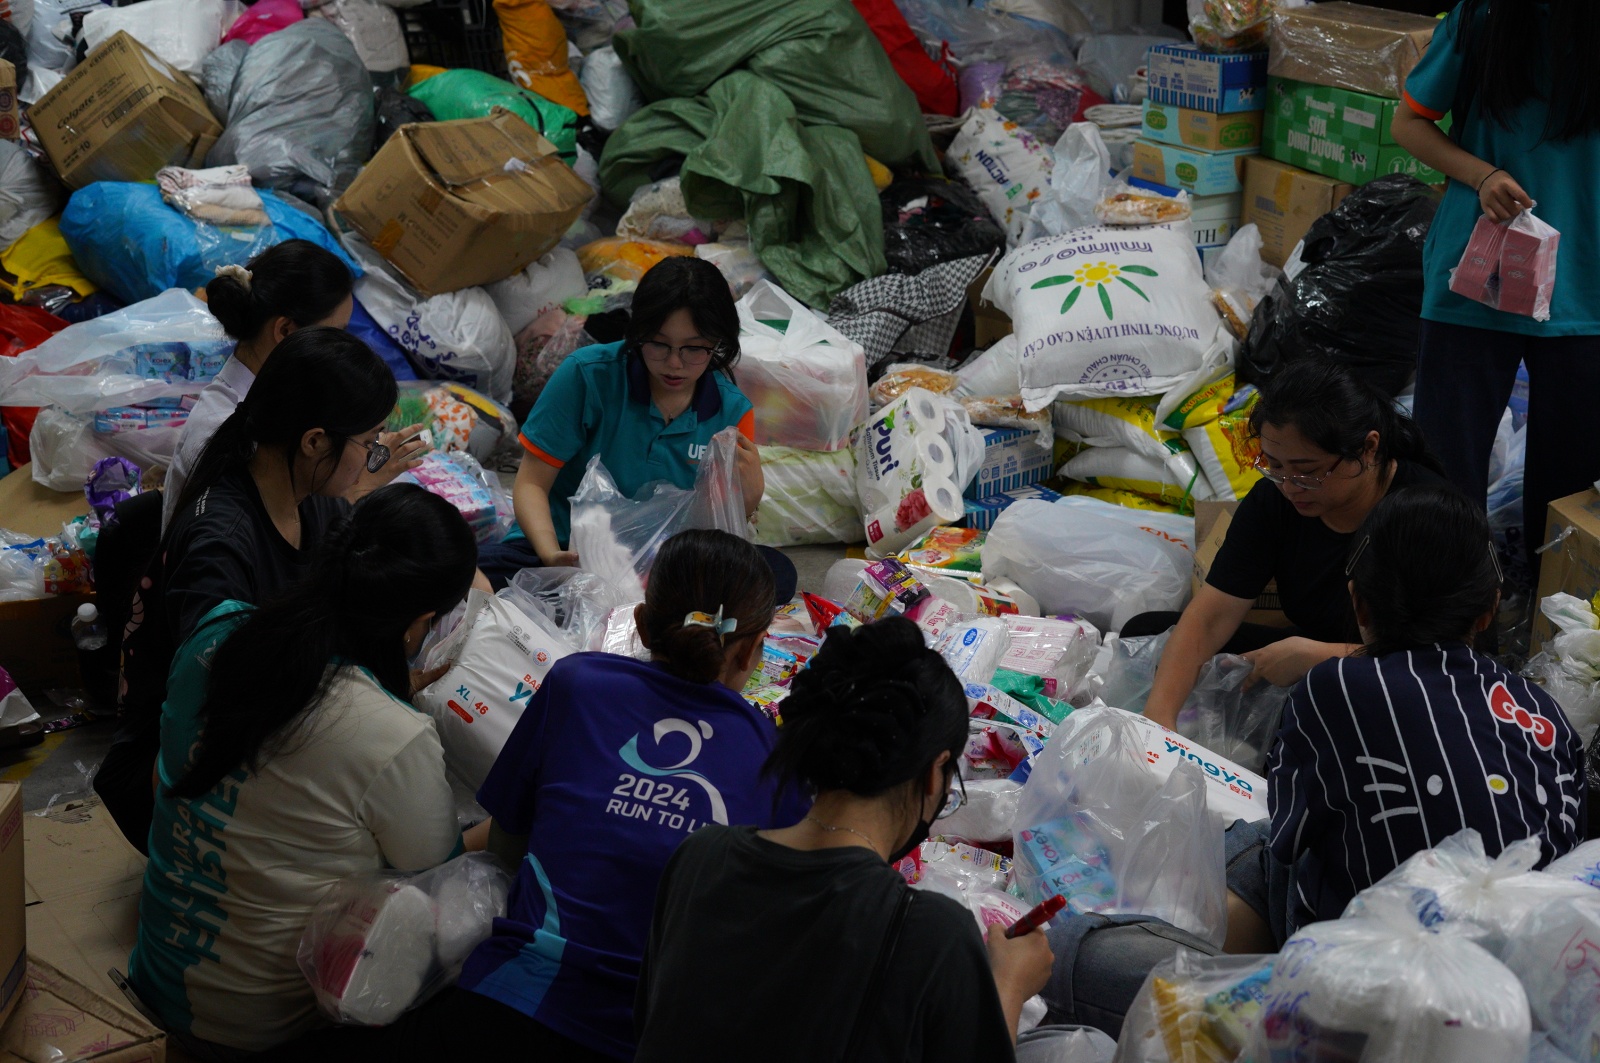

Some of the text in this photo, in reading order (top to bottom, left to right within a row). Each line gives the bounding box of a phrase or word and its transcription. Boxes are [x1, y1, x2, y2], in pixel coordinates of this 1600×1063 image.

[57, 94, 95, 130] Colgate
[1194, 229, 1216, 243] TH
[1018, 241, 1153, 273] mimosa
[1049, 330, 1075, 346] CAO
[1077, 325, 1120, 343] LUYỆN
[1121, 323, 1153, 336] TINH
[872, 417, 900, 477] puri
[456, 685, 469, 701] XL
[474, 701, 489, 715] 46
[1165, 737, 1190, 750] BABY
[612, 774, 690, 811] 2024
[605, 799, 653, 821] RUN
[658, 810, 684, 829] TO
